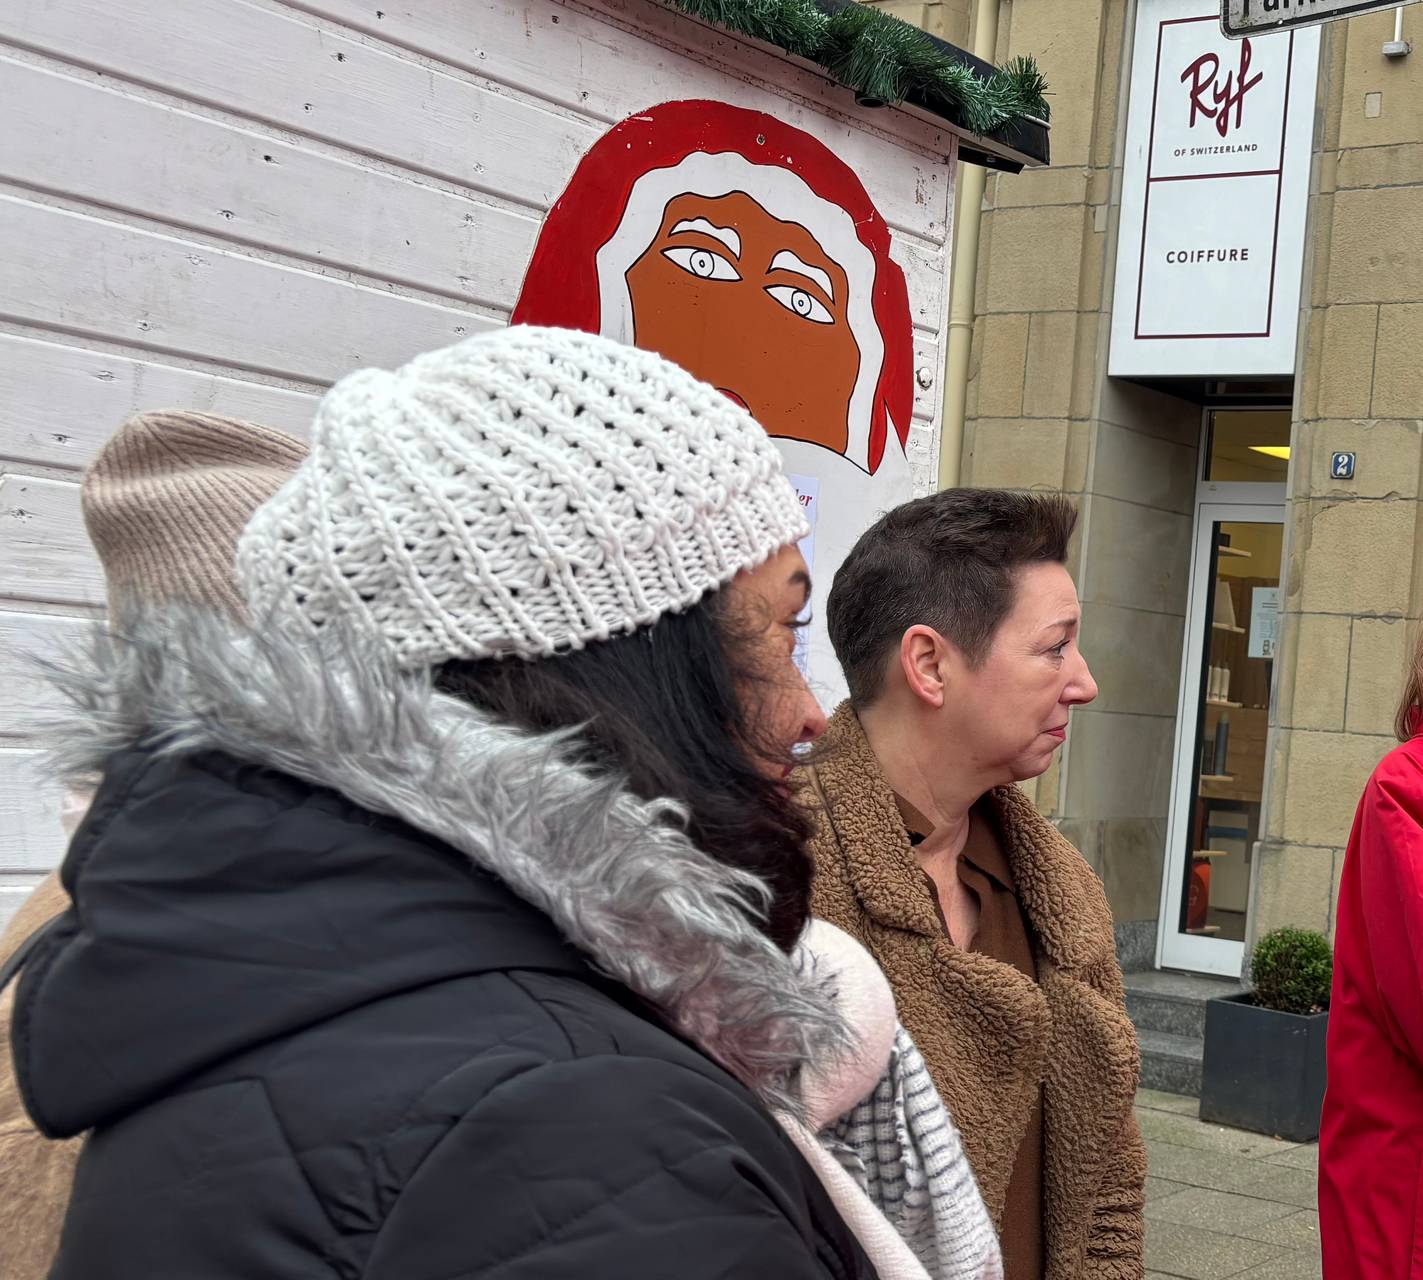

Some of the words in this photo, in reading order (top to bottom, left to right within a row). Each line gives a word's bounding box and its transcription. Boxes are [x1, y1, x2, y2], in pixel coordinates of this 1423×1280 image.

[1181, 37, 1264, 138] Ryf
[1174, 148, 1187, 157] OF
[1190, 143, 1258, 156] SWITZERLAND
[1166, 248, 1249, 264] COIFFURE
[1336, 454, 1349, 475] 2
